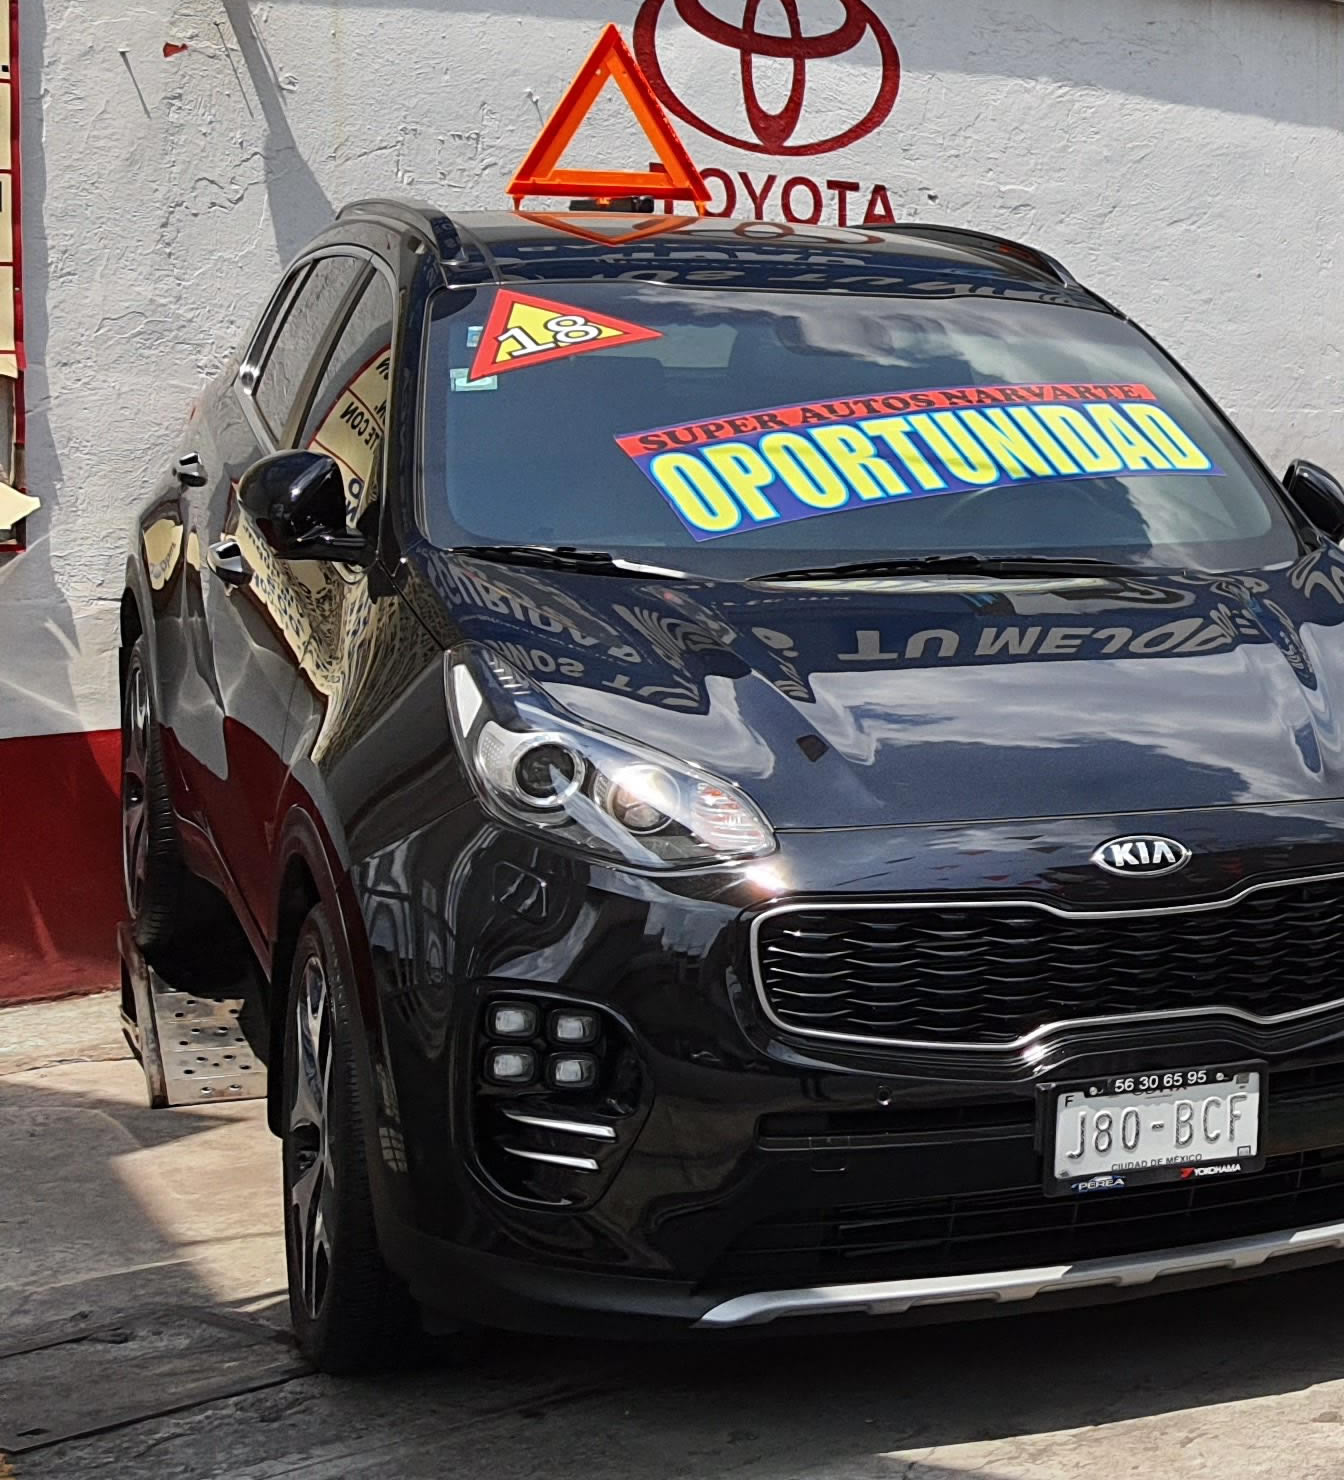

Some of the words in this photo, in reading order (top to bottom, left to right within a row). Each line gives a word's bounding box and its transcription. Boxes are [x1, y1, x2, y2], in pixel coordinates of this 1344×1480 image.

[496, 315, 603, 358] 18
[638, 411, 791, 452] SUPER
[800, 389, 942, 423] AUTOS
[944, 383, 1149, 406] NARVARTE
[650, 402, 1212, 532] OPORTUNIDAD
[1109, 841, 1176, 867] KIA
[1114, 1078, 1134, 1093] 56
[1139, 1075, 1158, 1090] 30
[1162, 1072, 1183, 1087] 65
[1187, 1070, 1207, 1085] 95
[1064, 1095, 1075, 1107] F
[1066, 1092, 1248, 1160] J80-BCF
[1111, 1160, 1148, 1171] CIUDAD
[1150, 1159, 1163, 1168] DE
[1193, 1163, 1241, 1177] YOKOHAMA
